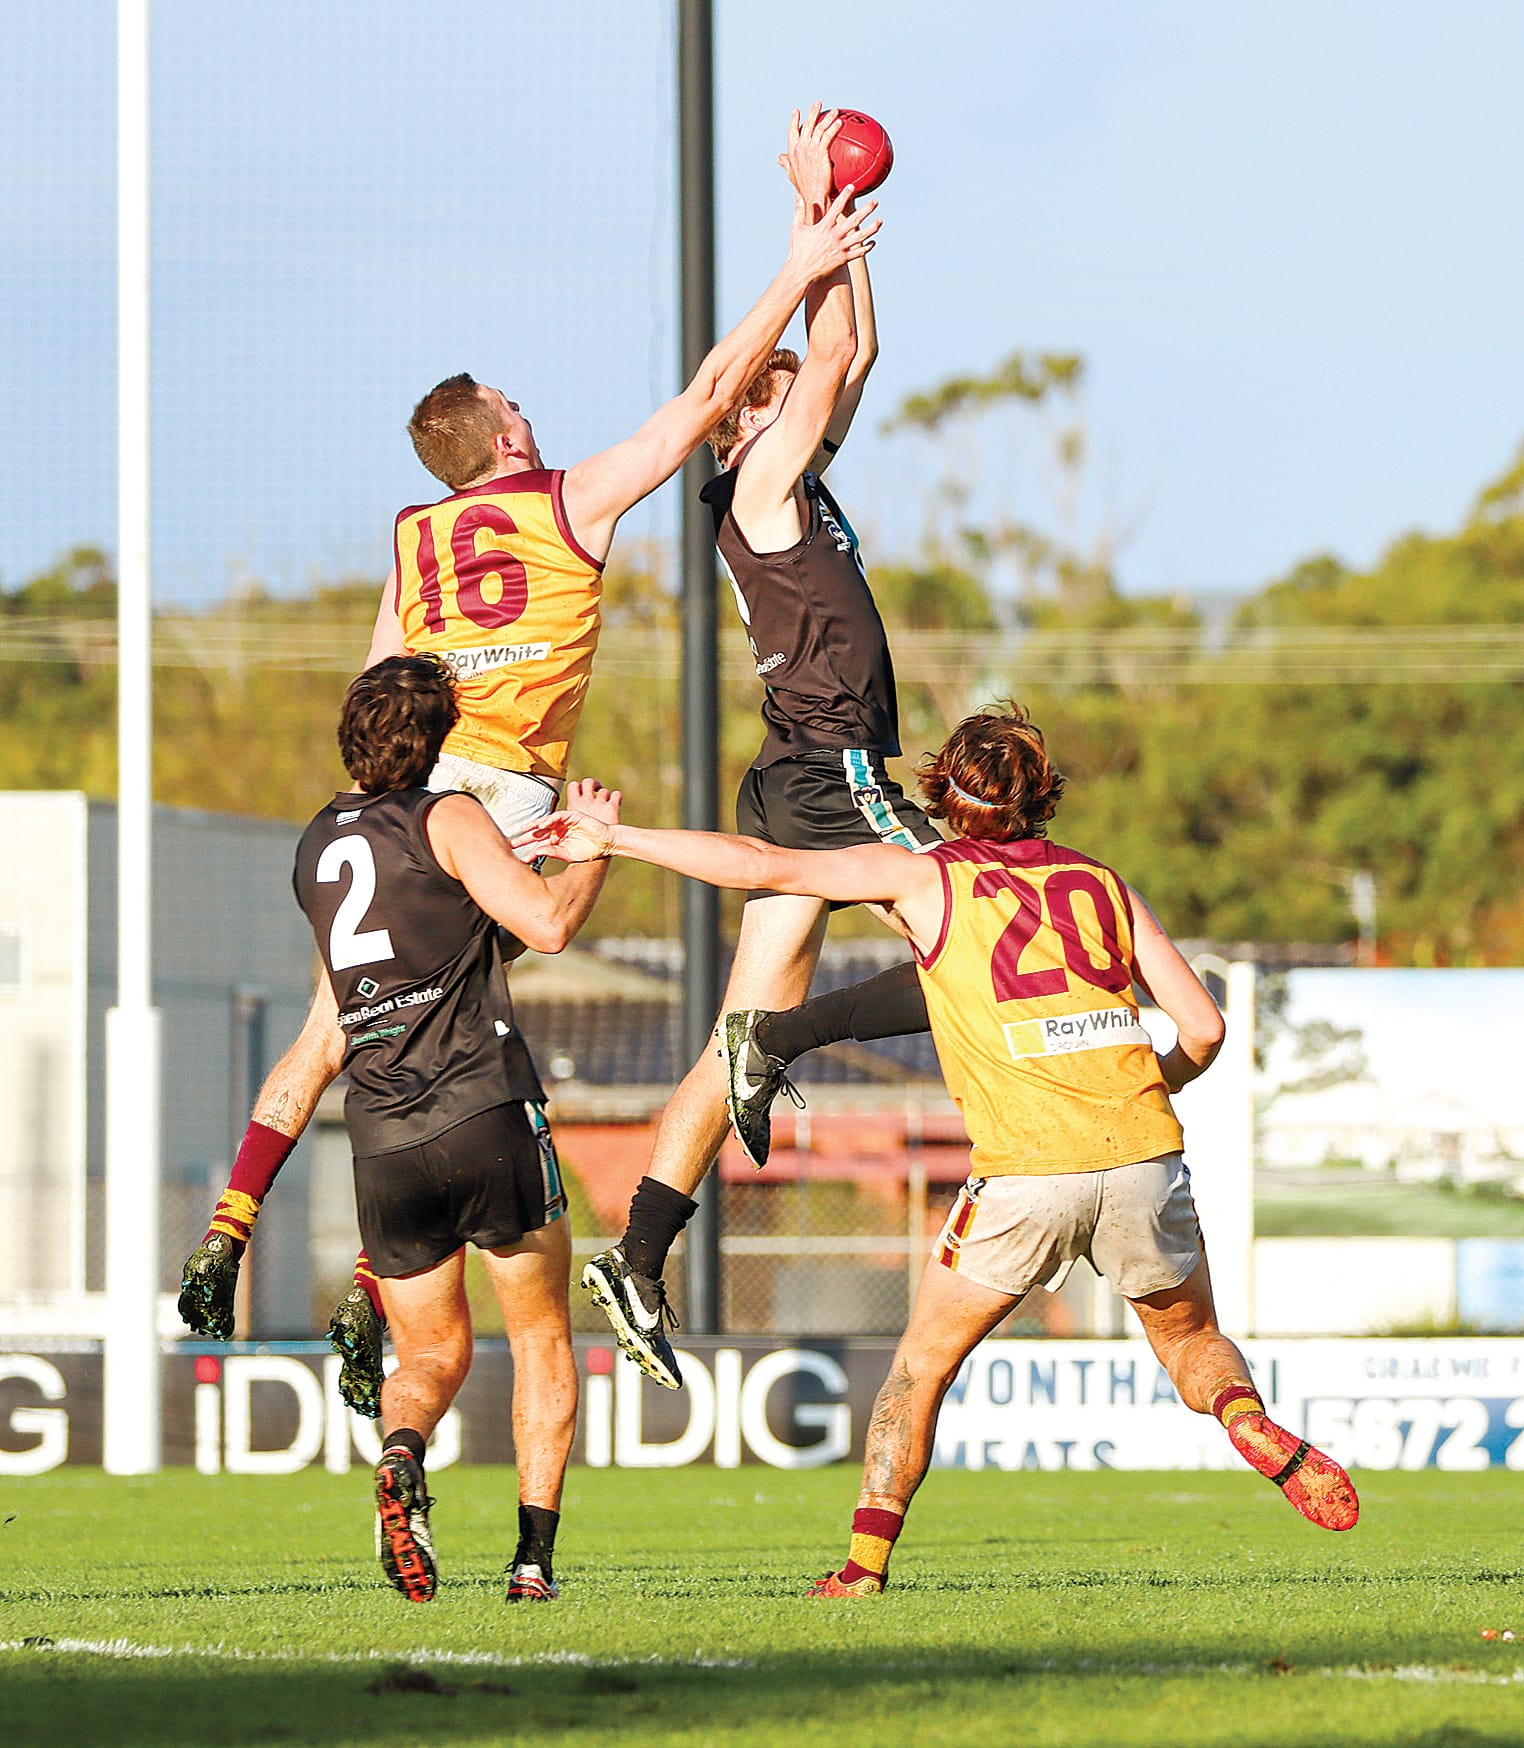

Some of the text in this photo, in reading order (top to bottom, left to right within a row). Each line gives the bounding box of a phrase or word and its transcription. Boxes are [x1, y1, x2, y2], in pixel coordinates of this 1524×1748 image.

[416, 503, 528, 635] 16
[316, 833, 396, 973] 2
[972, 868, 1132, 1004] 20
[394, 987, 444, 1009] Estate
[1045, 1008, 1136, 1038] RayWhit
[585, 1346, 852, 1470] iDIG
[941, 1358, 1281, 1406] WONTHAI
